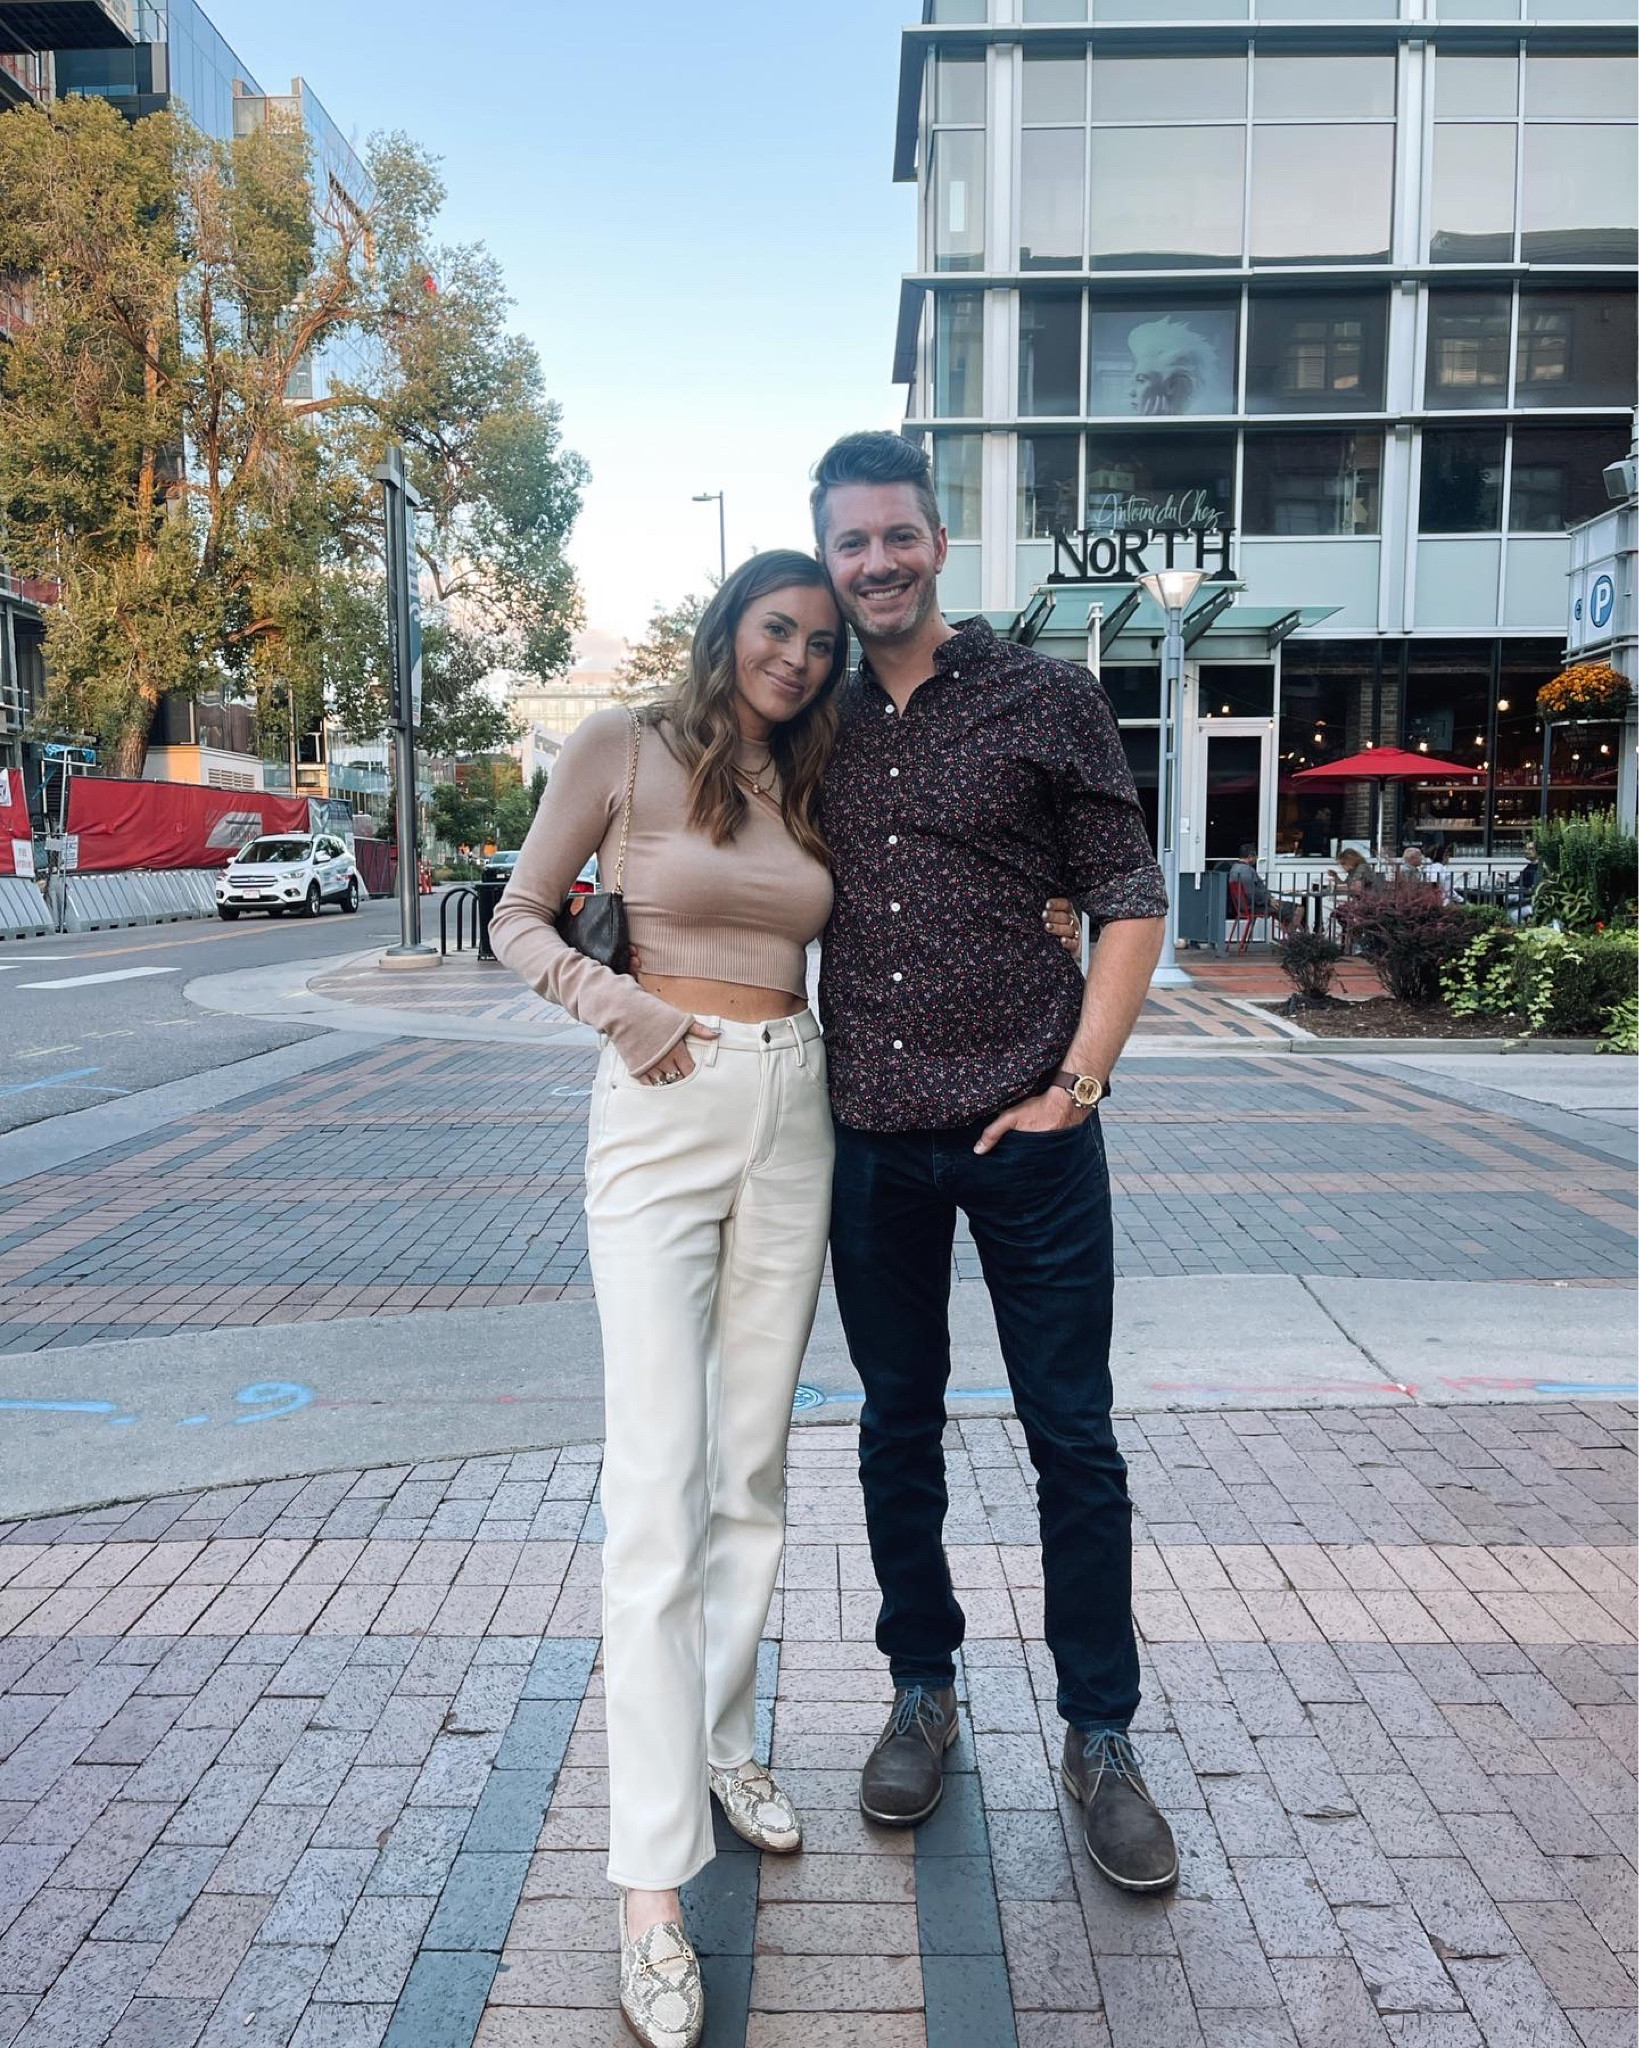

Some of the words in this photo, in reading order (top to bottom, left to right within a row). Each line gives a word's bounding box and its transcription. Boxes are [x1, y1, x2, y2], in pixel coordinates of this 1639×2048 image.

[1178, 489, 1225, 530] Chez
[1048, 527, 1236, 578] NORTH
[1594, 582, 1611, 623] P
